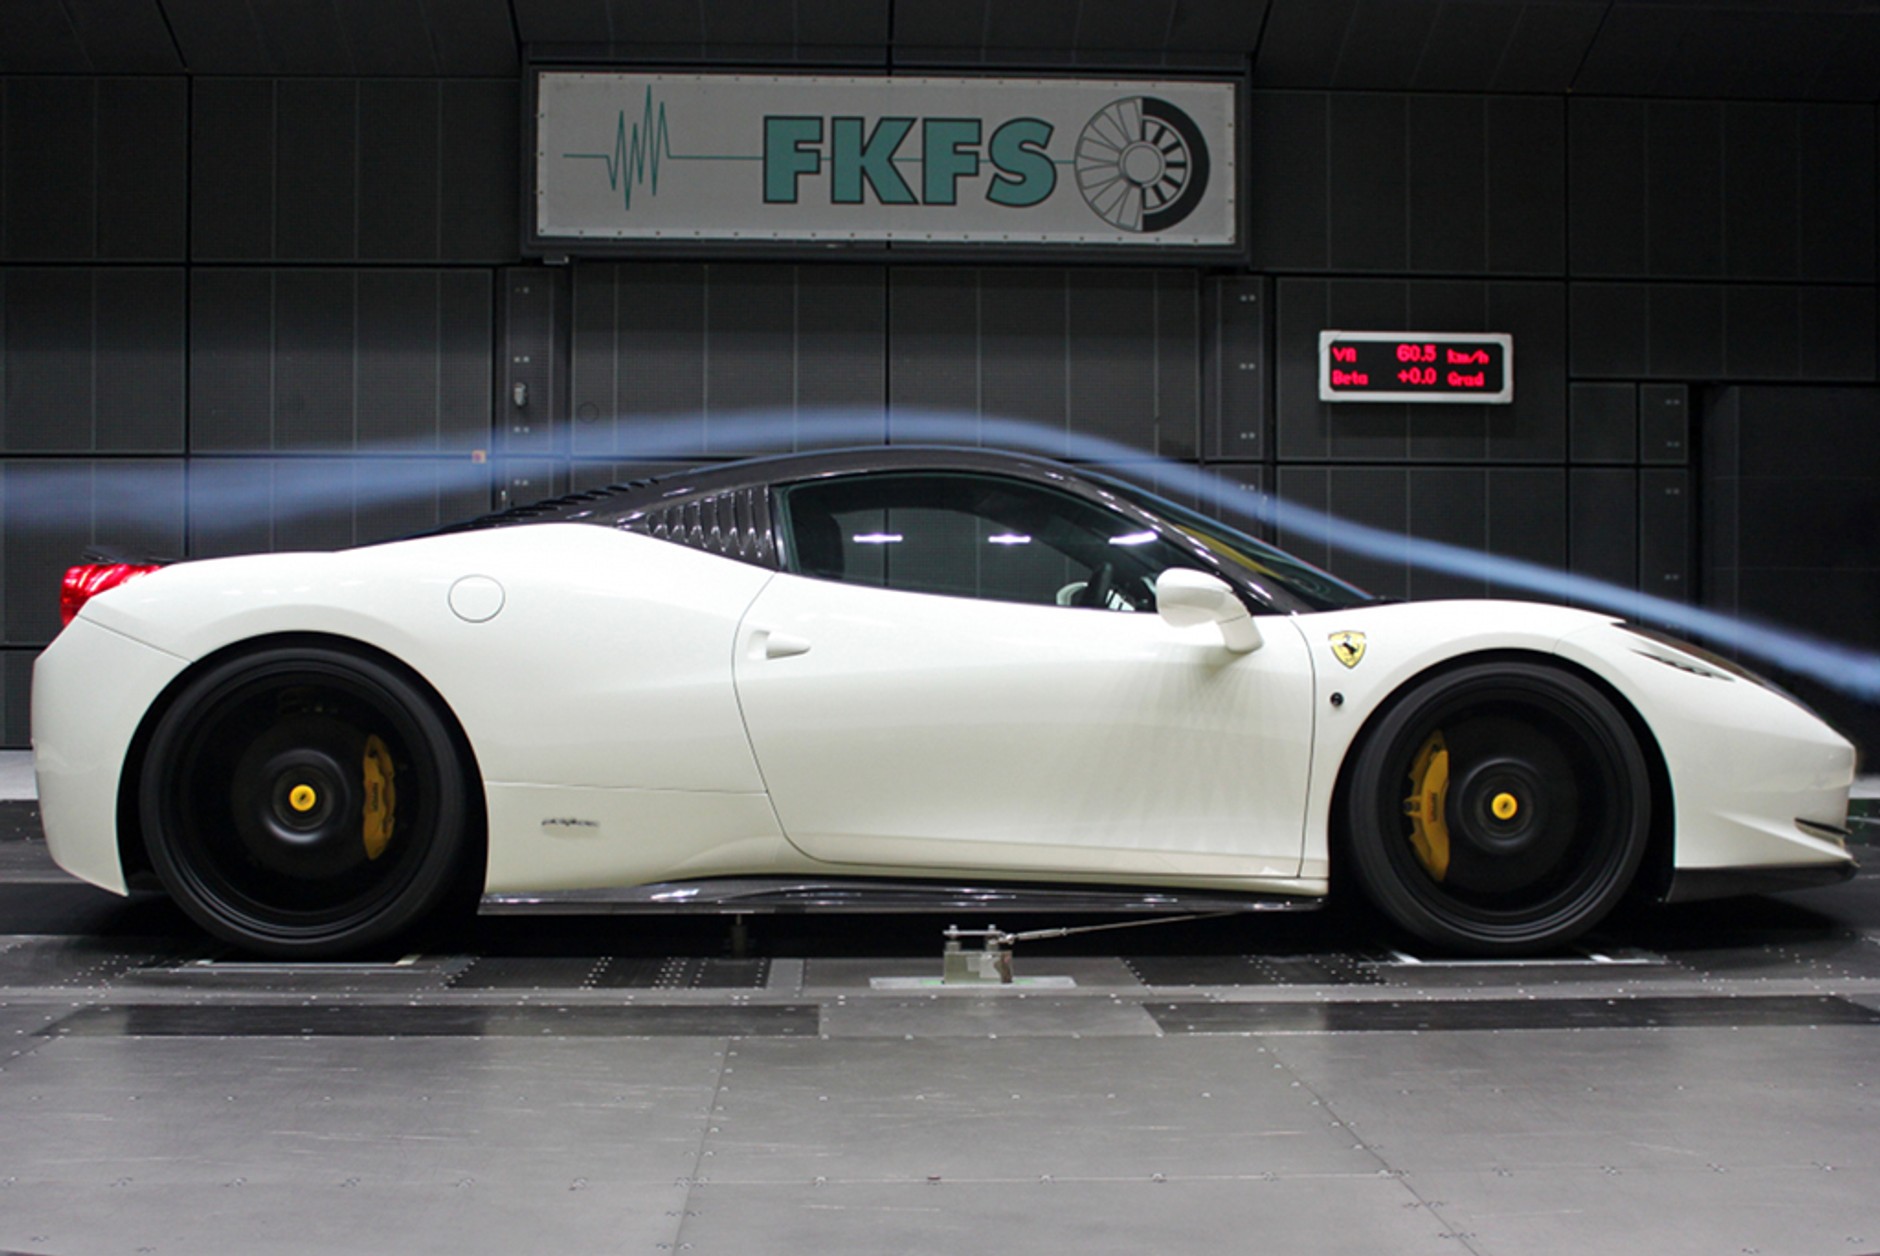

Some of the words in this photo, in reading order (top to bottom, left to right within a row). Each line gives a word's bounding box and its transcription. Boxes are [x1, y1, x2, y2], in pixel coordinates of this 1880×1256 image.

[763, 116, 1057, 208] FKFS
[1396, 344, 1436, 362] 60.5
[1446, 349, 1489, 364] km/h
[1332, 370, 1368, 385] Beta
[1398, 367, 1437, 384] +0.0
[1447, 371, 1484, 386] Grad
